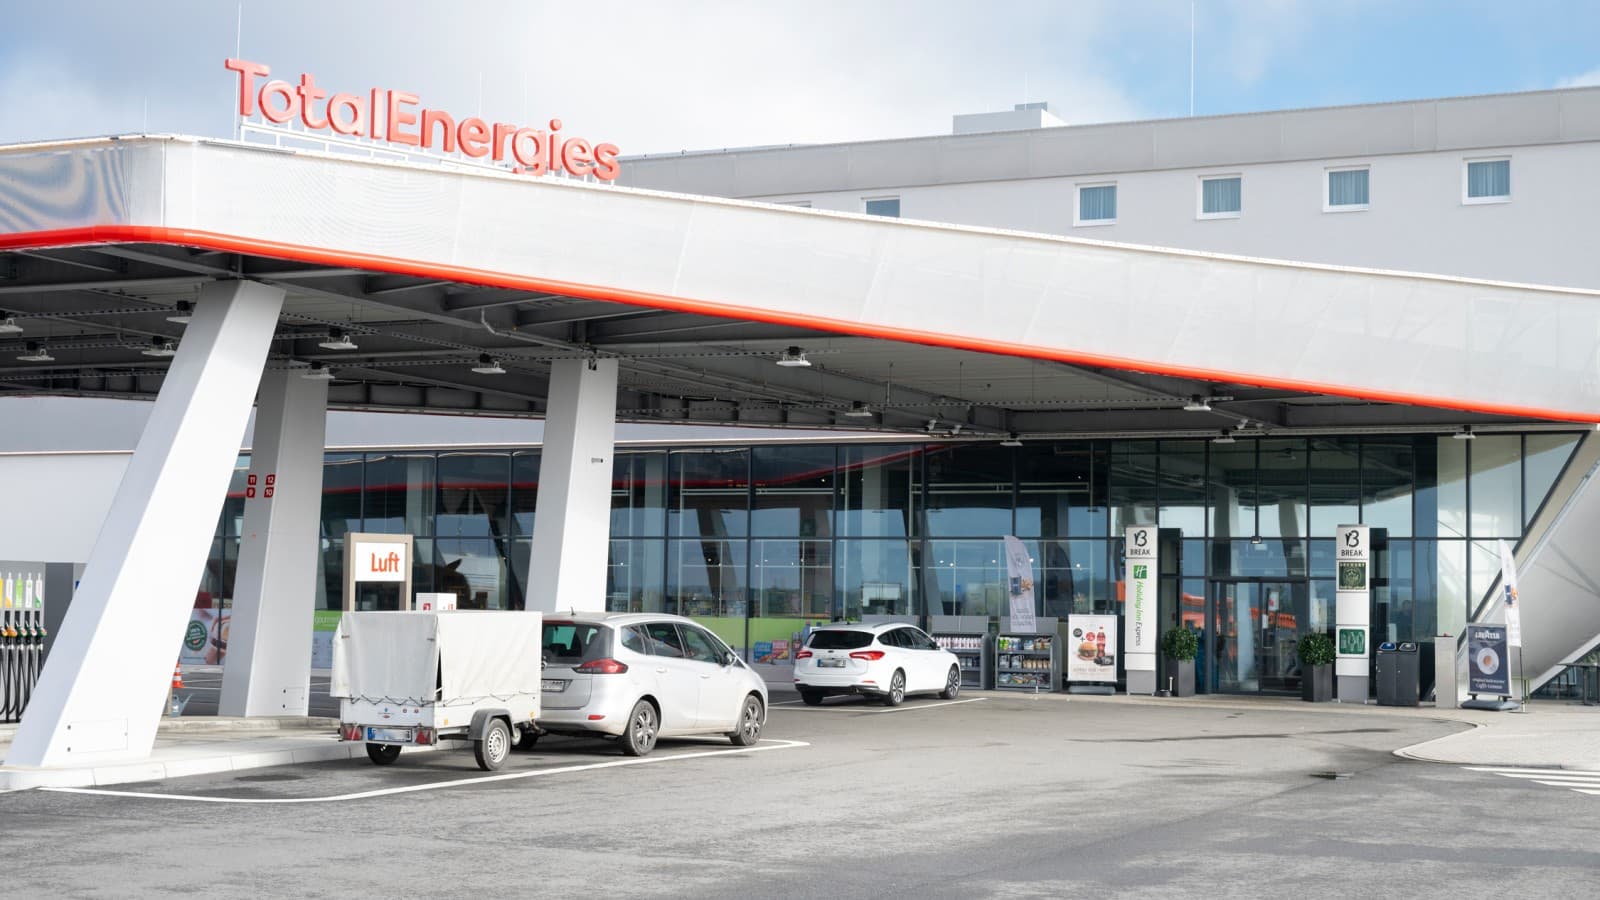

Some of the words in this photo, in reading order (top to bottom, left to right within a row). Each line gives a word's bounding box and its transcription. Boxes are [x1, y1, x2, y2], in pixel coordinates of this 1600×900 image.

[225, 58, 620, 180] TotalEnergies
[371, 551, 400, 573] Luft
[1341, 549, 1363, 557] BREAK
[1134, 581, 1144, 608] Holiday
